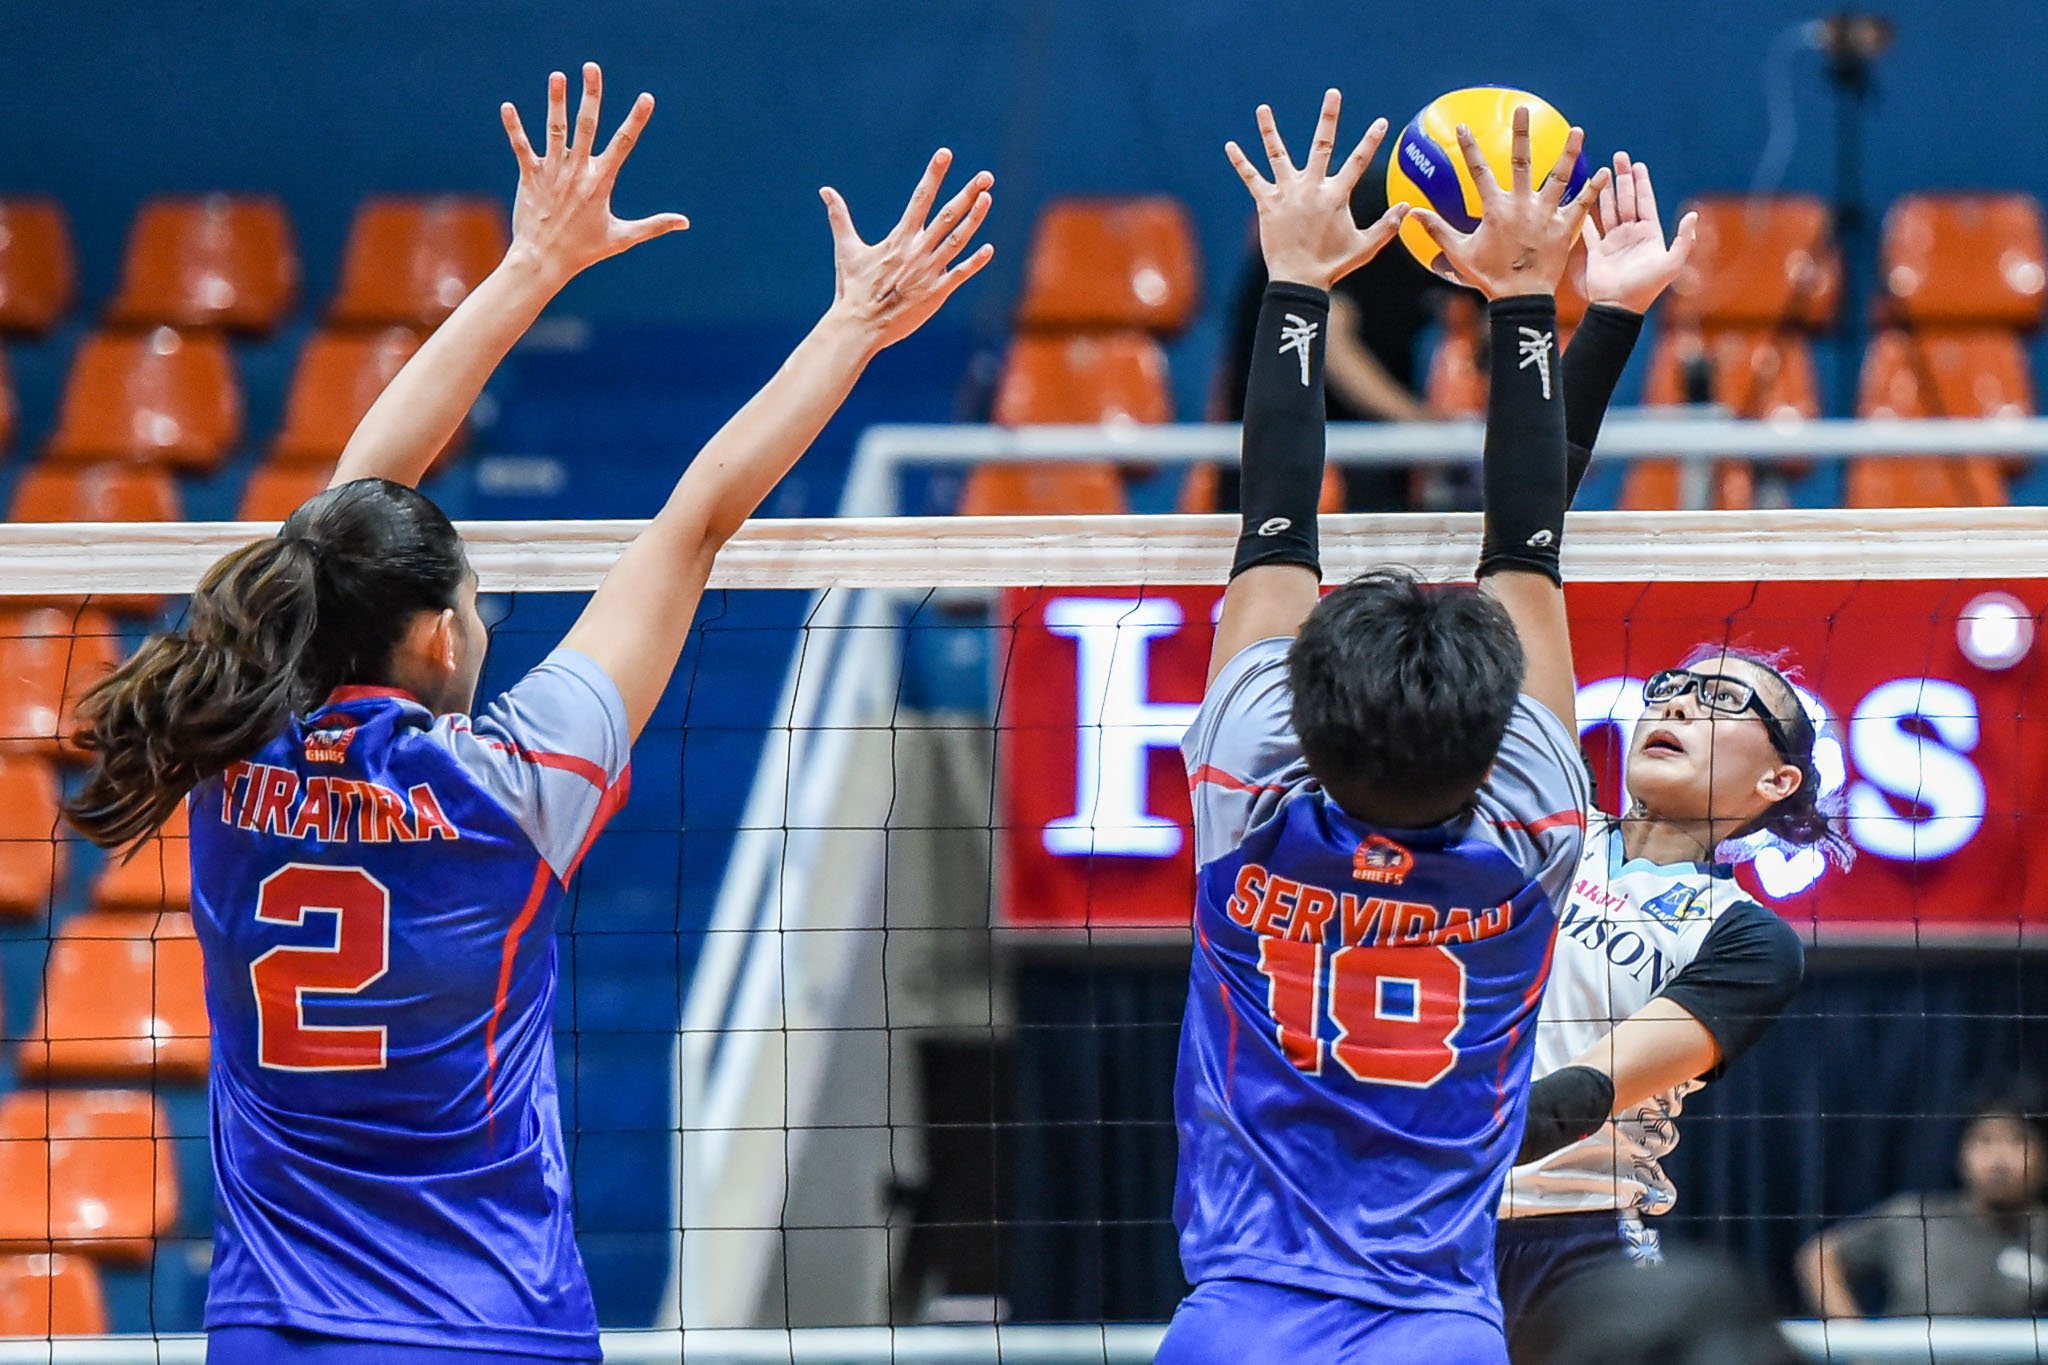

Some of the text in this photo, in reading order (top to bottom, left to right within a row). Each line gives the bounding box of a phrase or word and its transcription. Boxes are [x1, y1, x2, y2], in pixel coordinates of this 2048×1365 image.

[1405, 142, 1436, 180] V200W
[221, 760, 460, 843] TIRATIRA
[1226, 863, 1513, 946] SERVIDAD
[1352, 868, 1404, 886] CHIEFS
[1573, 879, 1630, 913] Akari
[250, 862, 390, 1072] 2
[1560, 903, 1675, 996] MSON
[1257, 935, 1467, 1090] 18
